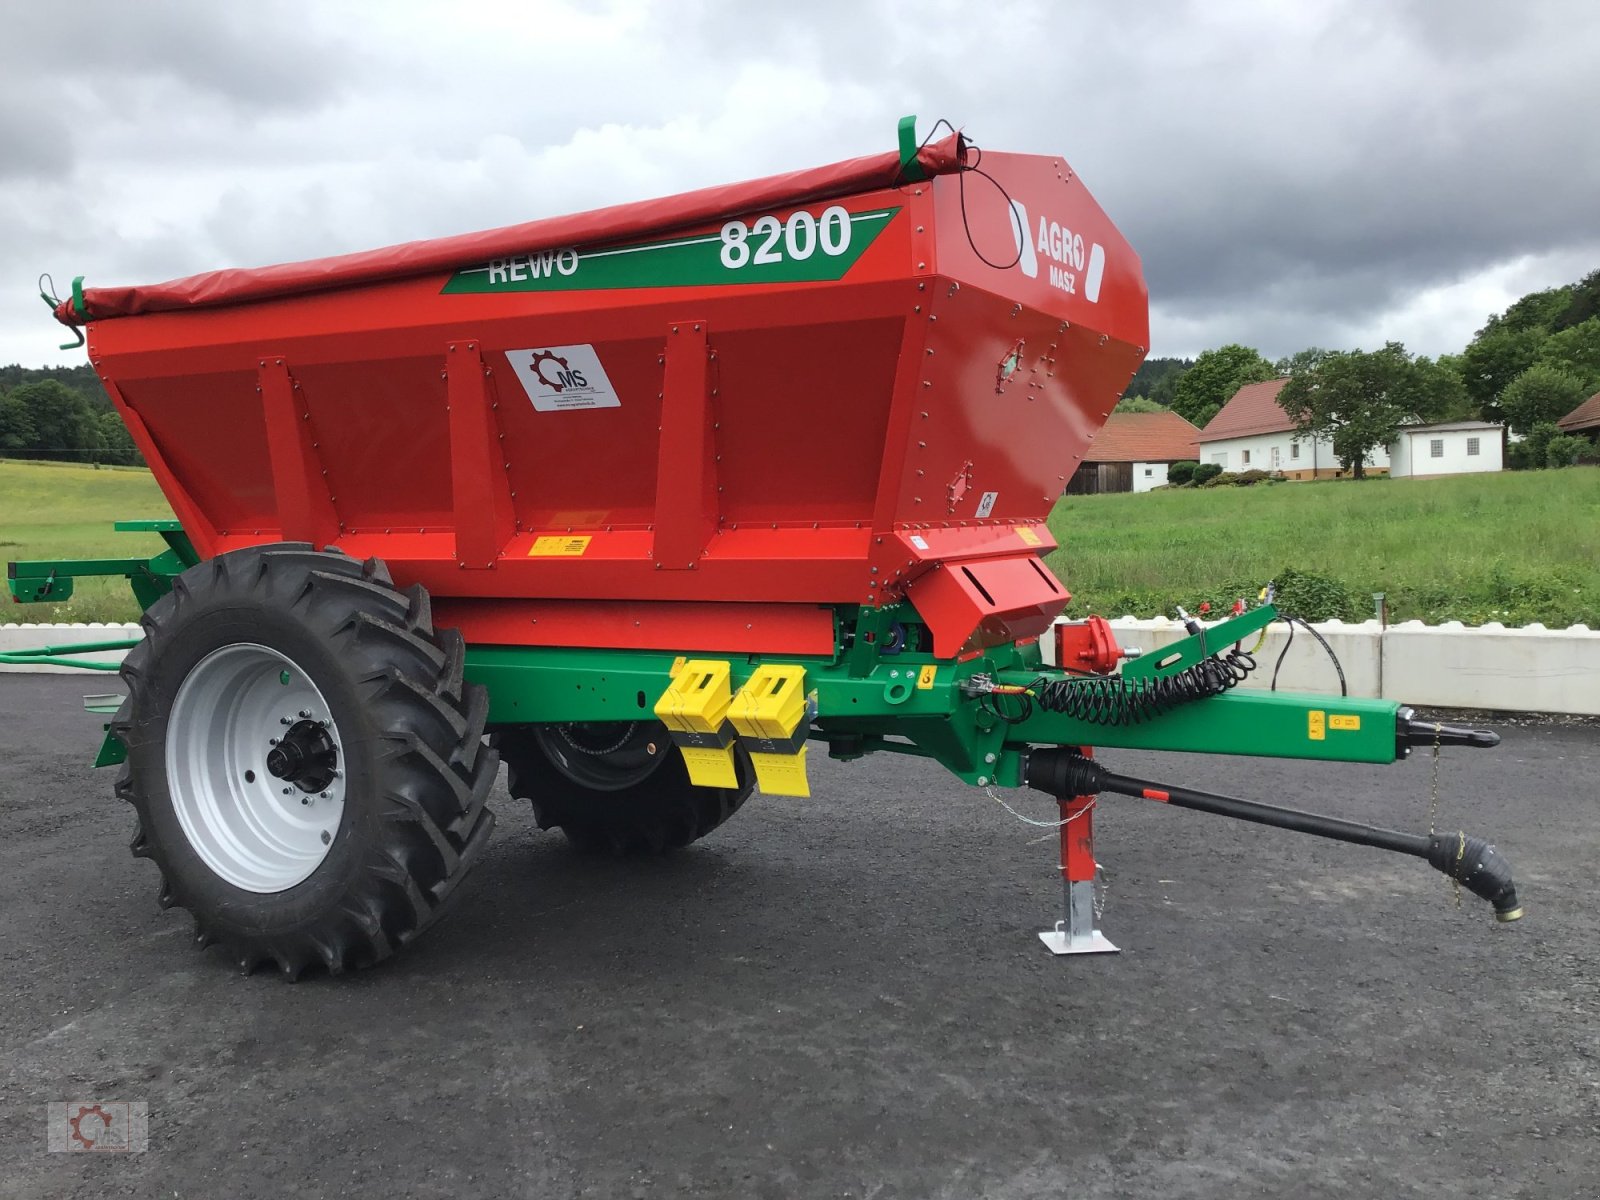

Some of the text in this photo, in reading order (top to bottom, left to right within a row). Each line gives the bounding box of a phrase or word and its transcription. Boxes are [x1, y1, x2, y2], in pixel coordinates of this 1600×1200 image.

[720, 205, 851, 269] 8200
[1037, 215, 1085, 272] AGRO
[489, 248, 579, 284] REWO
[1049, 265, 1076, 295] MASZ
[556, 369, 588, 388] MS
